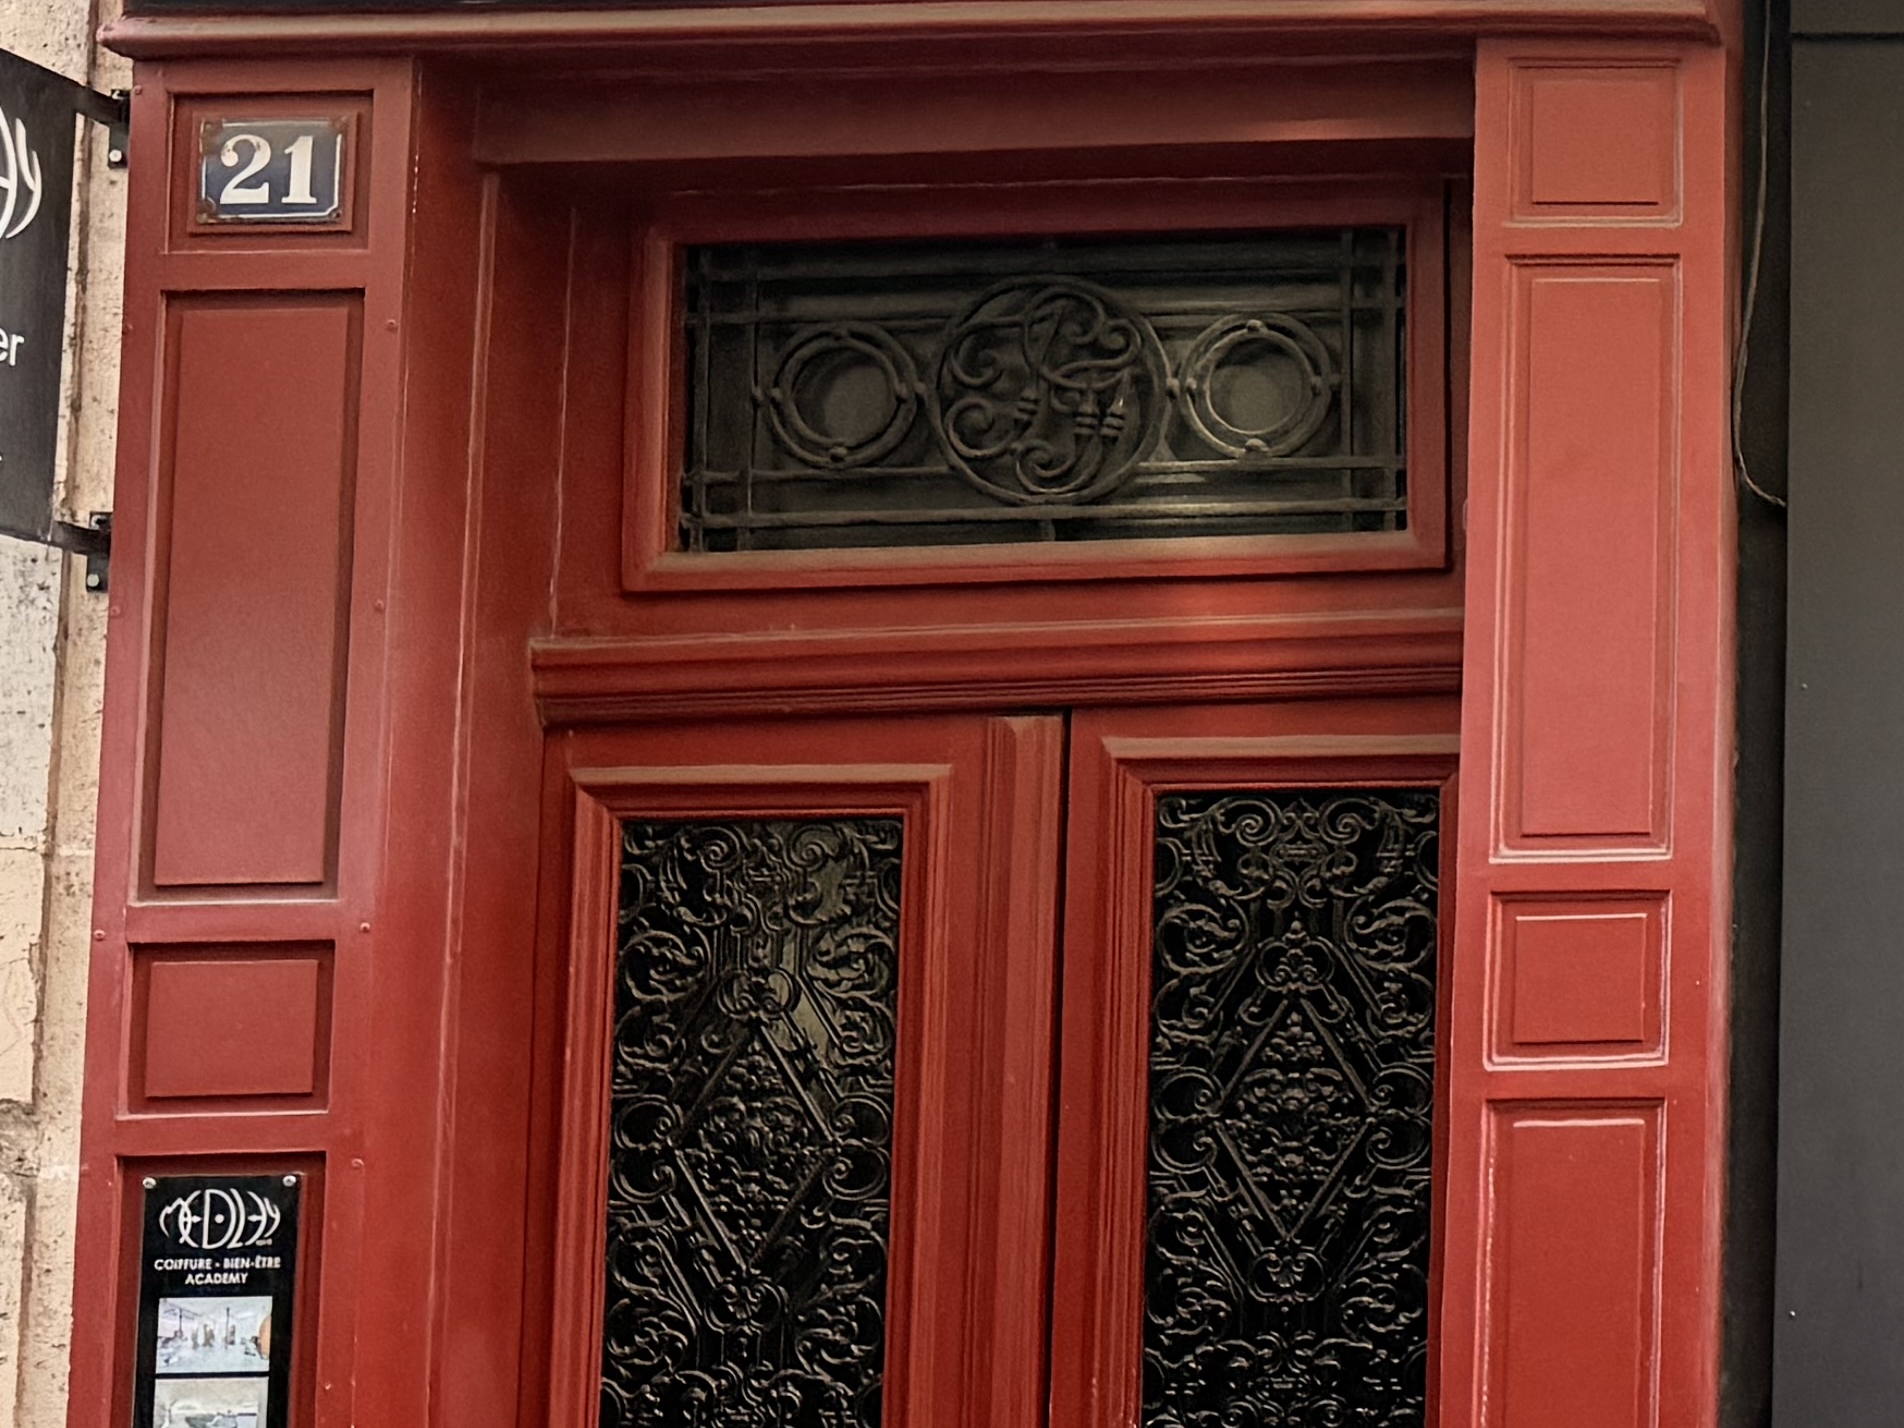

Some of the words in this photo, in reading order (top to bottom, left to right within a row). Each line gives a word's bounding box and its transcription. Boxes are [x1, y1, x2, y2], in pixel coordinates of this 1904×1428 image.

[219, 133, 317, 206] 21
[154, 1259, 213, 1270] COIFFURE
[185, 1272, 248, 1285] ACADEMY
